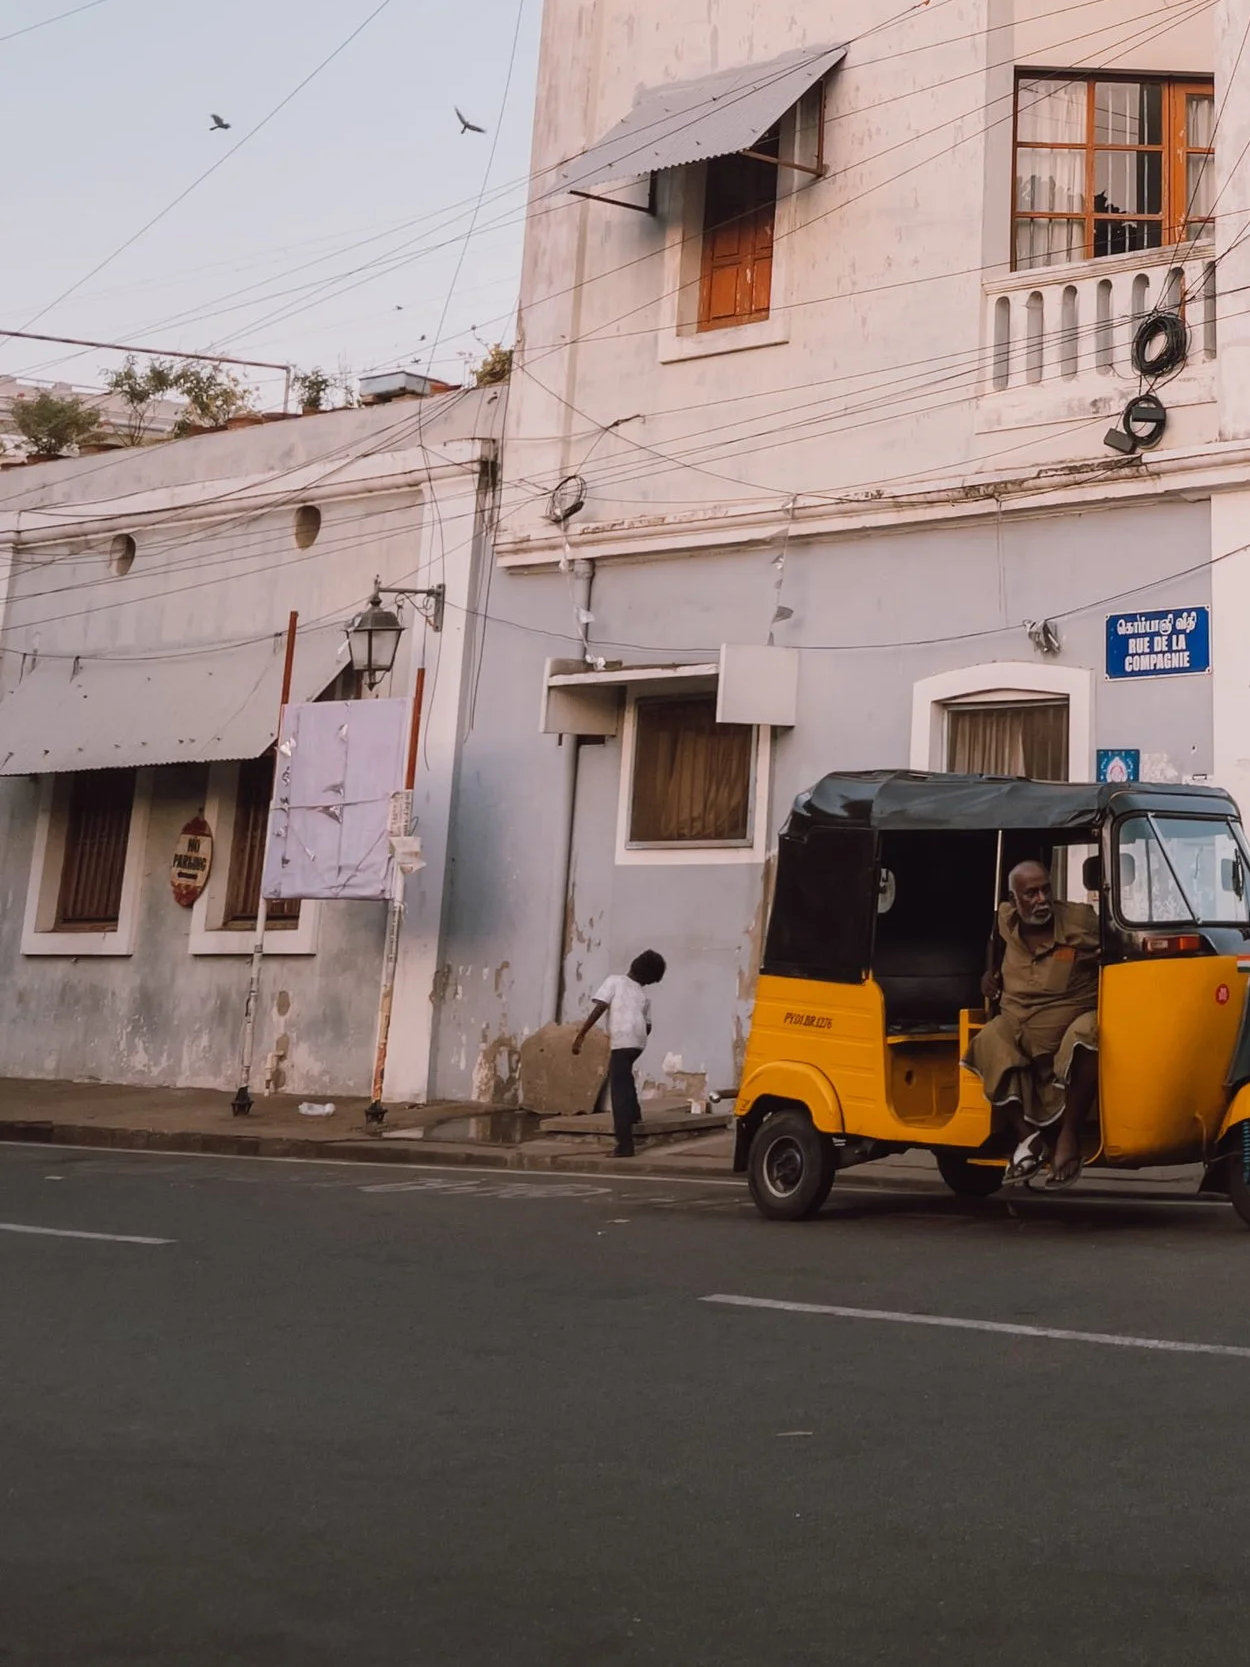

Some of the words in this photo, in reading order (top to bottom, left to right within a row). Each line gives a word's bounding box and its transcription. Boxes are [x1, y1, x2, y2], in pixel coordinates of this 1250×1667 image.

[1128, 637, 1150, 654] RUE
[1154, 636, 1168, 652] DE
[1172, 634, 1186, 650] LA
[1125, 651, 1190, 672] COMPAGNIE
[187, 838, 201, 853] NO
[172, 854, 207, 872] PARKING
